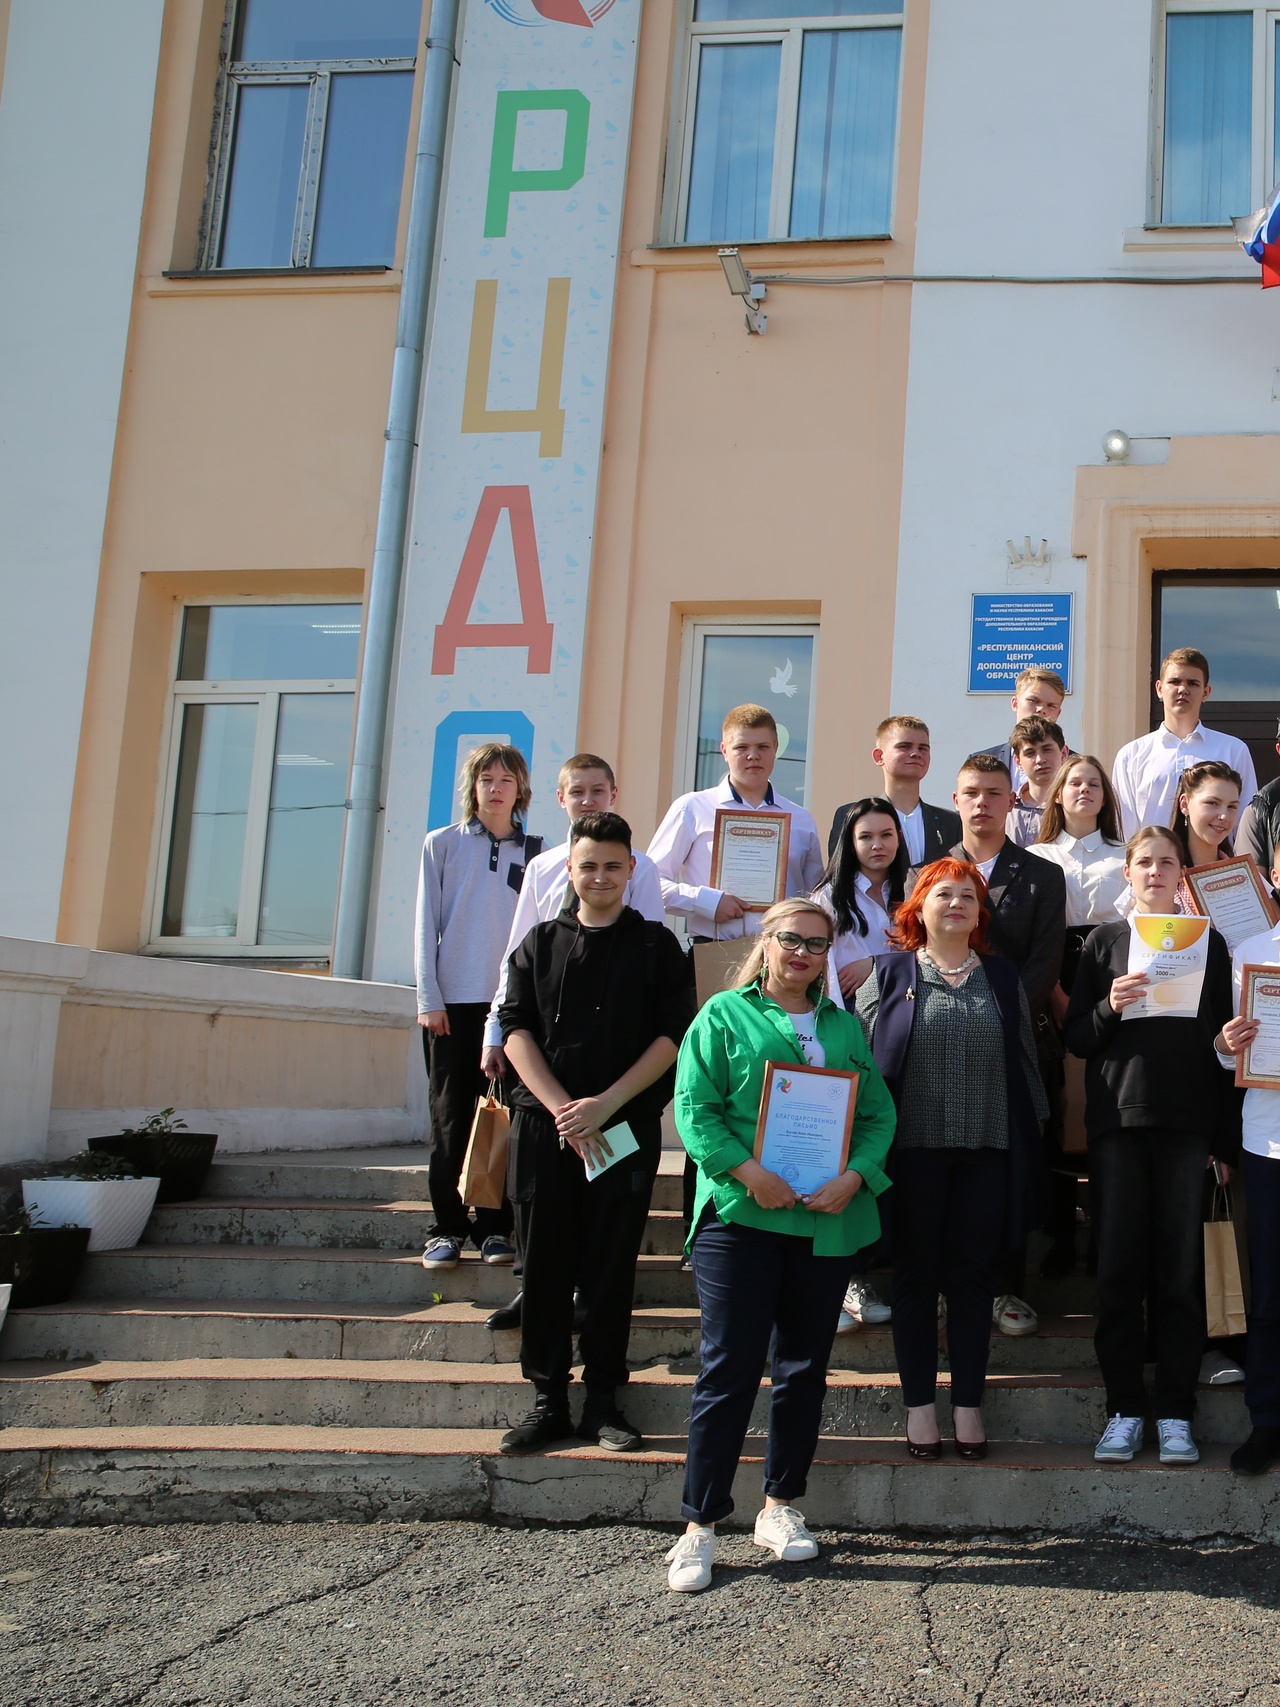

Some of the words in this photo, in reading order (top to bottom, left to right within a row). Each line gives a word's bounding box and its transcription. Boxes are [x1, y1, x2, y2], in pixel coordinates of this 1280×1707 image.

[977, 642, 1064, 651] «РЕСПУБЛИКАНСКИЙ
[1006, 653, 1034, 661] ЦЕНТР
[976, 662, 1063, 671] ДОПОЛНИТЕЛЬНОГО
[732, 828, 774, 837] СЕРТИФИКАТ
[1206, 876, 1244, 891] СЕРТИФИКАТ
[1142, 952, 1197, 961] СЕРТИФИКАТ
[775, 1113, 837, 1126] БЛАГОДАРСТВЕННОЕ
[793, 1122, 818, 1130] ПИСЬМО
